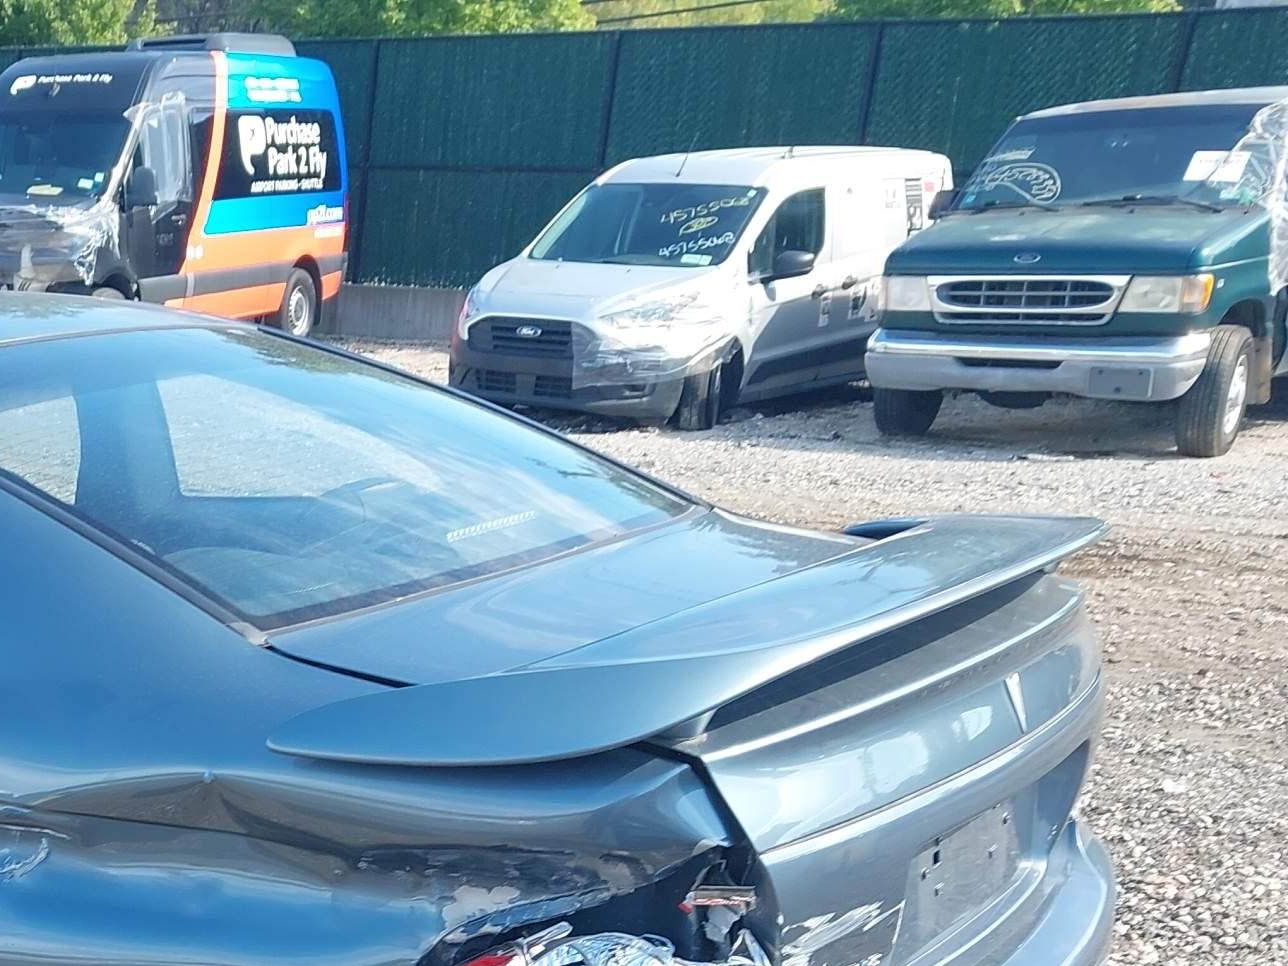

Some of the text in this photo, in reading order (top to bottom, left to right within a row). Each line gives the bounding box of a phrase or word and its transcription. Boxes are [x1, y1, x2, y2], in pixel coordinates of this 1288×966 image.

[264, 114, 321, 145] Purchase
[268, 144, 328, 181] Park 2 Fly
